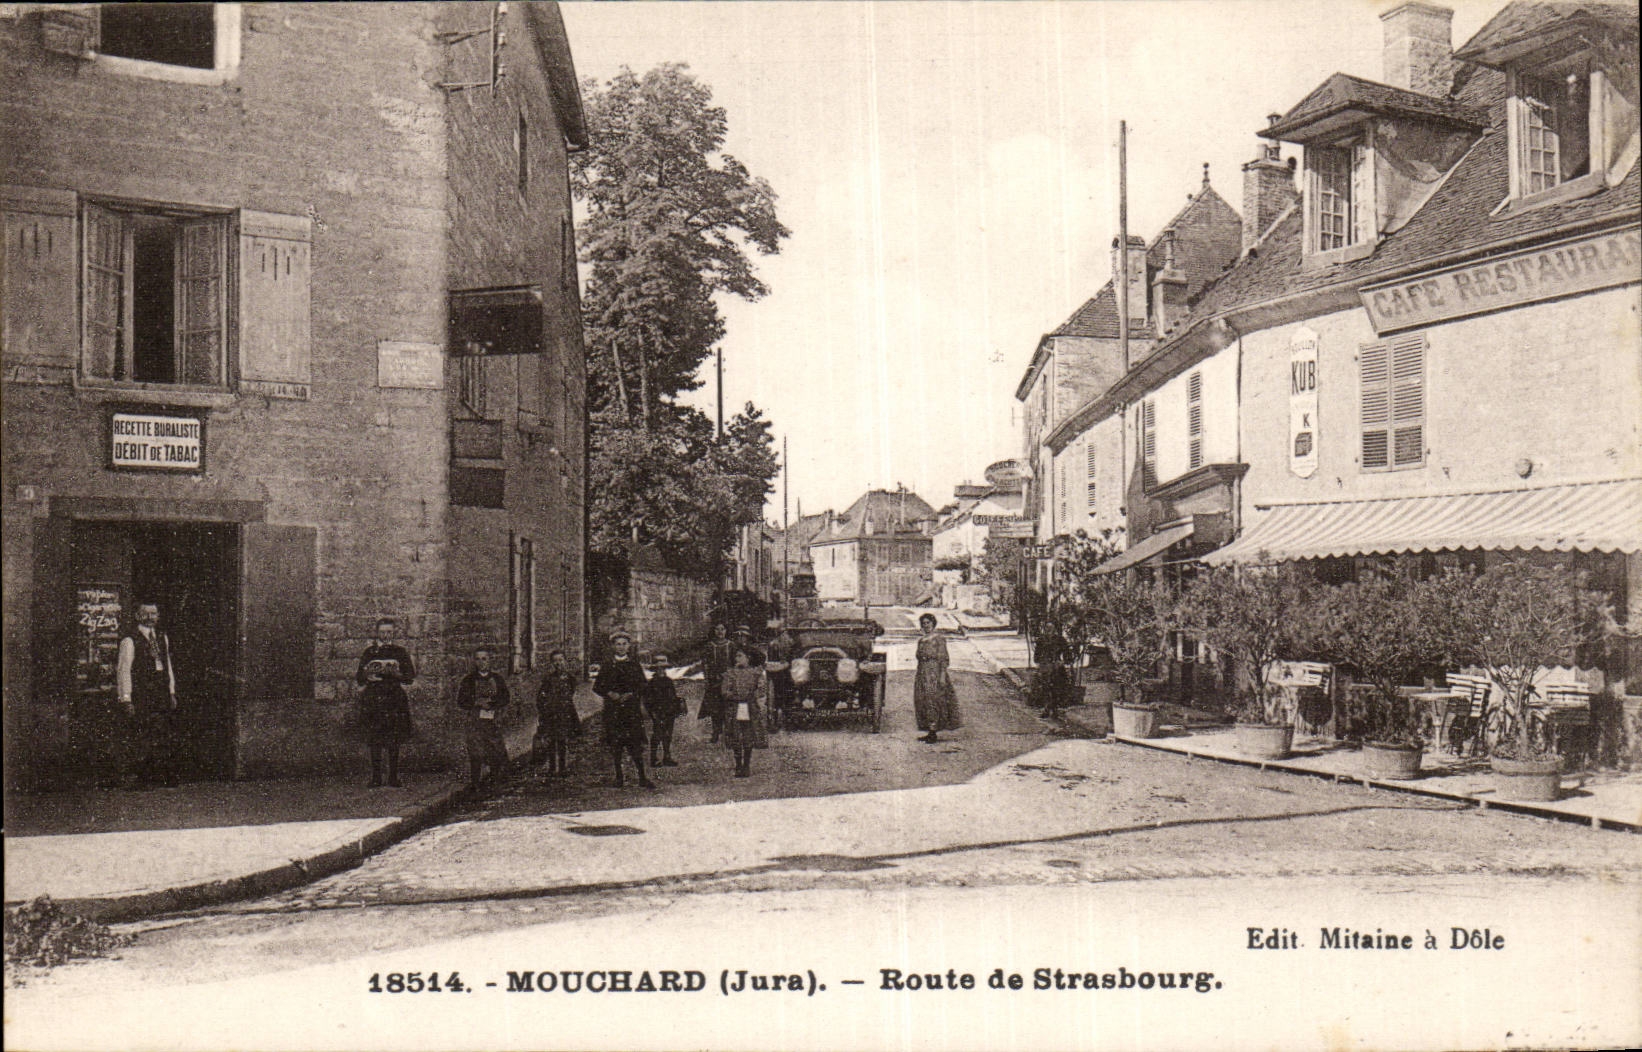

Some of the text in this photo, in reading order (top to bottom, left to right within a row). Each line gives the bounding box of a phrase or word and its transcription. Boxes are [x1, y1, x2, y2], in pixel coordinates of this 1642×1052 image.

[1291, 360, 1316, 396] KUB
[114, 420, 199, 439] RECETTE BURALISTE
[1303, 412, 1312, 428] K
[115, 441, 198, 463] DÉBIT DE TABAC
